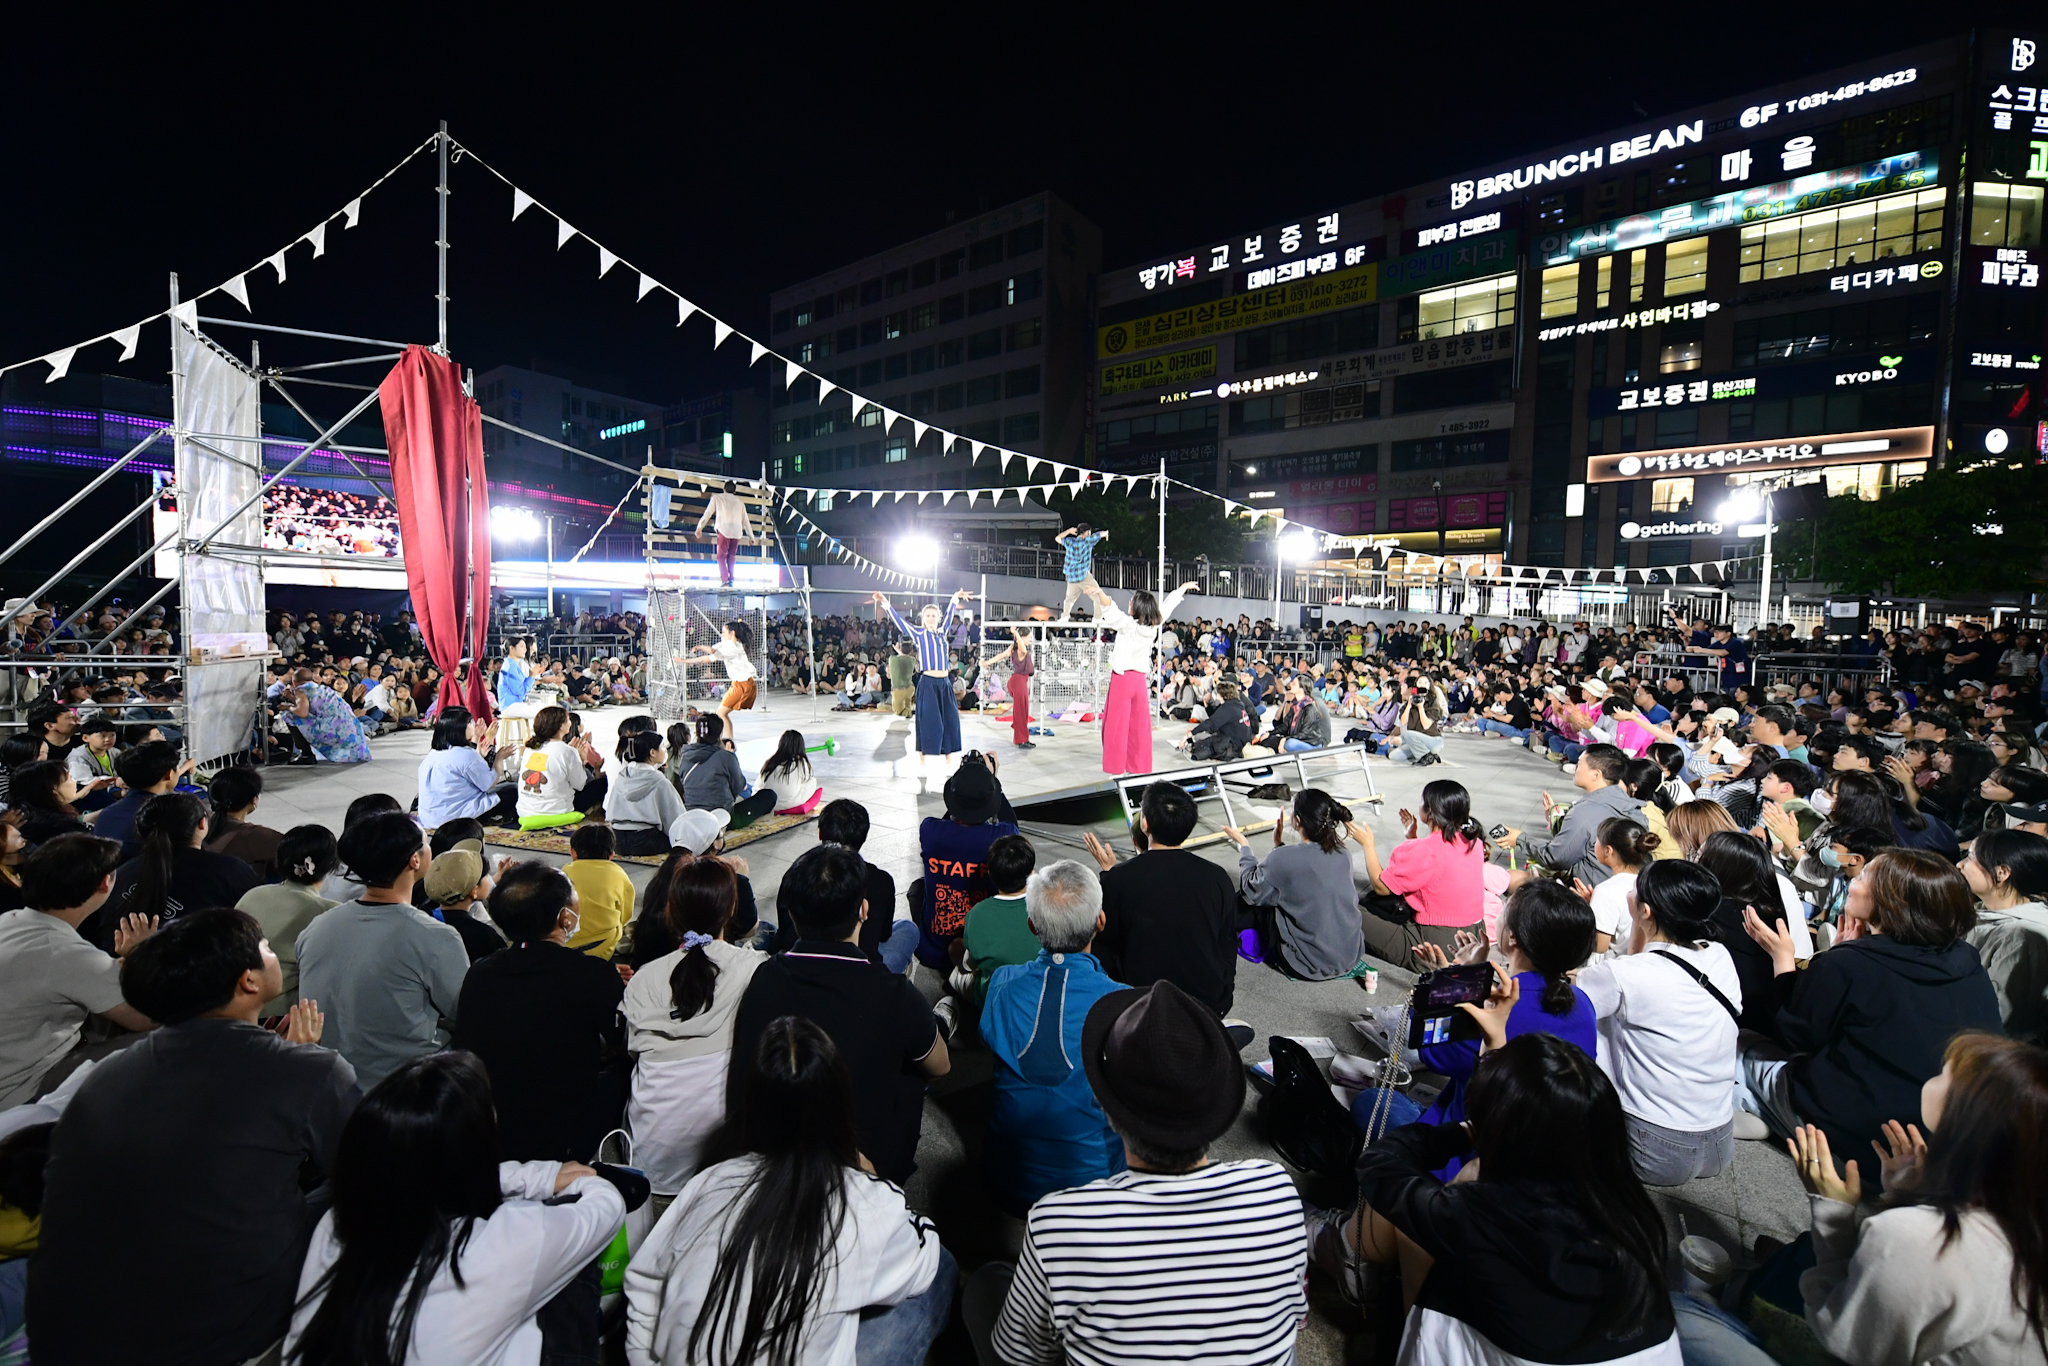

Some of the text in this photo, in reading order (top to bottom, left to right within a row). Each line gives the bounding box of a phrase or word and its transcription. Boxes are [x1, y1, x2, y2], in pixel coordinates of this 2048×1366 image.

[1477, 148, 1602, 199] BRUNCH
[1609, 121, 1703, 162] BEAN
[1740, 102, 1779, 128] 6F
[1742, 171, 1925, 221] 031.475-7455
[1418, 212, 1500, 246] 피부과 전문의
[1539, 223, 1610, 264] 안산
[1659, 196, 1735, 239] 문고
[1248, 245, 1365, 289] 데이즈피부과 6F
[1996, 248, 2028, 263] 데이즈
[1139, 256, 1196, 290] 명가복
[1830, 263, 1919, 293] 터디카페
[1981, 261, 2039, 287] 피부과
[1154, 275, 1367, 332] 심리상담센터 031)410-3272
[1106, 349, 1212, 383] 축구&테니스 아카데미
[1320, 354, 1375, 378] 세무회계
[1971, 353, 2012, 368] 교보증권
[1836, 368, 1897, 385] KYOBO
[1160, 392, 1188, 403] PARK
[1618, 378, 1756, 410] 교보증권 안산지점
[1712, 388, 1756, 399] 484-6011
[1640, 521, 1723, 538] gathering
